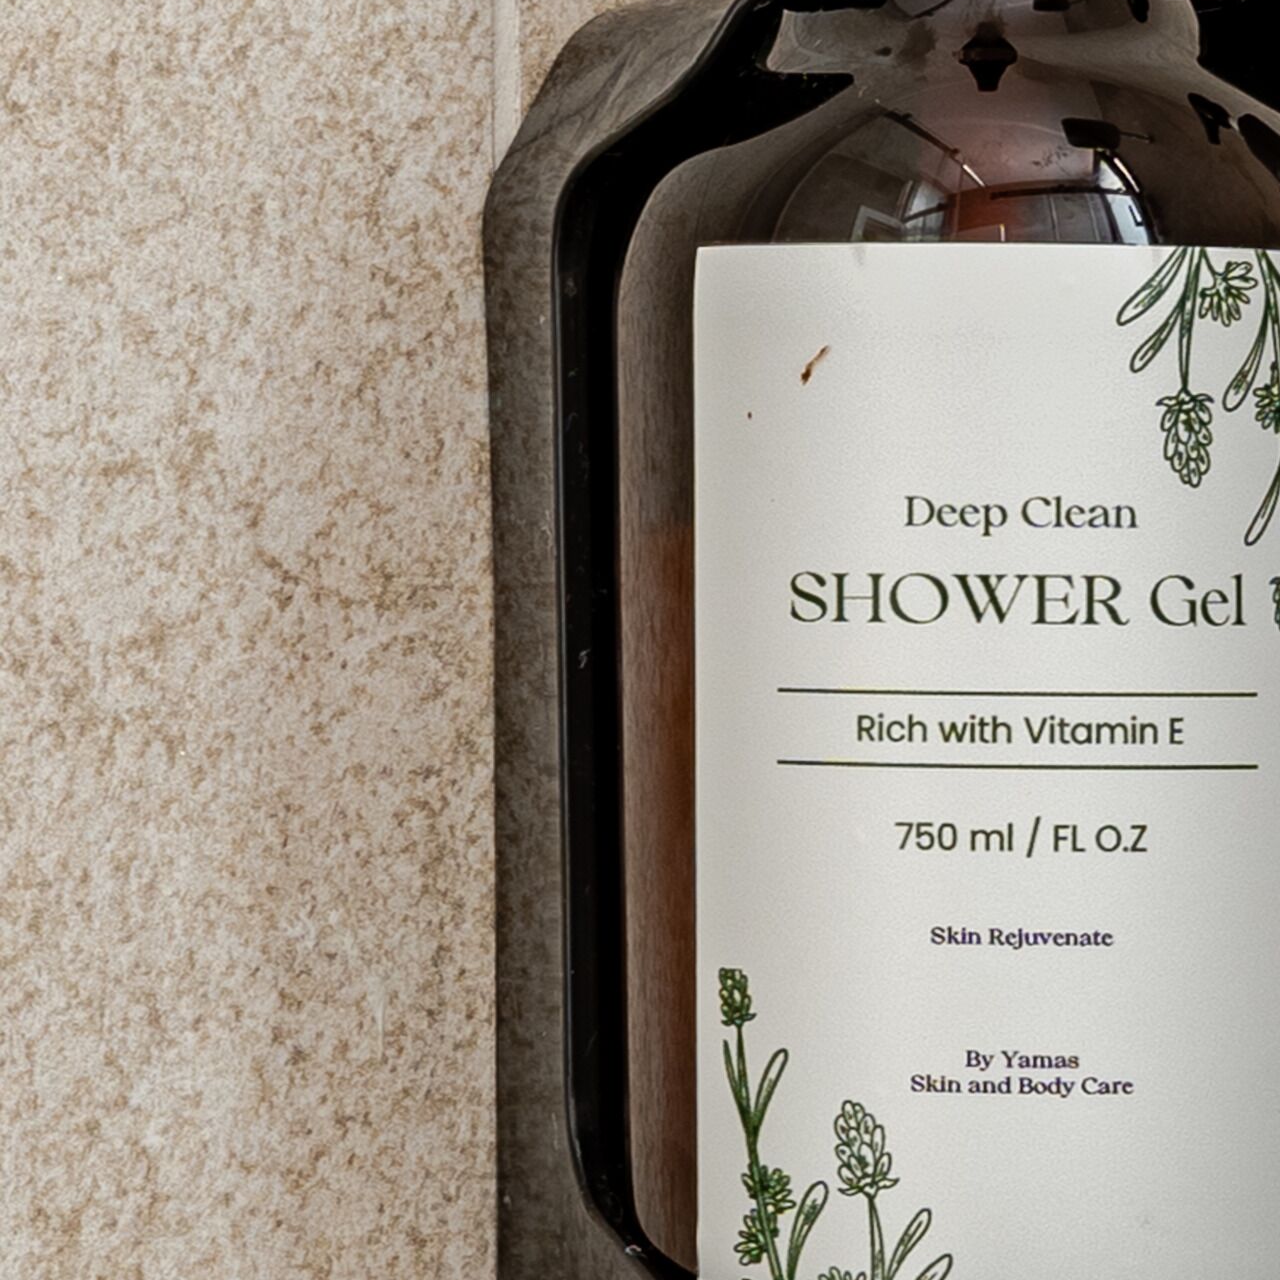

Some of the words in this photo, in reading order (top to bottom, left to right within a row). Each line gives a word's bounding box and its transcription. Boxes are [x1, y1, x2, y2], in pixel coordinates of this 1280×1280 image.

[904, 495, 1009, 538] Deep
[1020, 495, 1138, 529] Clean
[789, 570, 1131, 627] SHOWER
[1149, 573, 1247, 627] Gel
[856, 712, 928, 743] Rich
[937, 713, 1013, 745] with
[1023, 714, 1159, 746] Vitamin
[1168, 716, 1185, 746] E
[894, 821, 958, 852] 750
[969, 821, 1014, 853] ml
[1052, 823, 1087, 853] FL
[930, 925, 983, 946] Skin
[987, 927, 1114, 951] Rejuvenate
[965, 1049, 995, 1072] By
[1000, 1049, 1080, 1070] Yamas
[910, 1073, 963, 1094] Skin
[967, 1075, 1013, 1095] and
[1017, 1076, 1076, 1099] Body
[1080, 1076, 1134, 1096] Care
